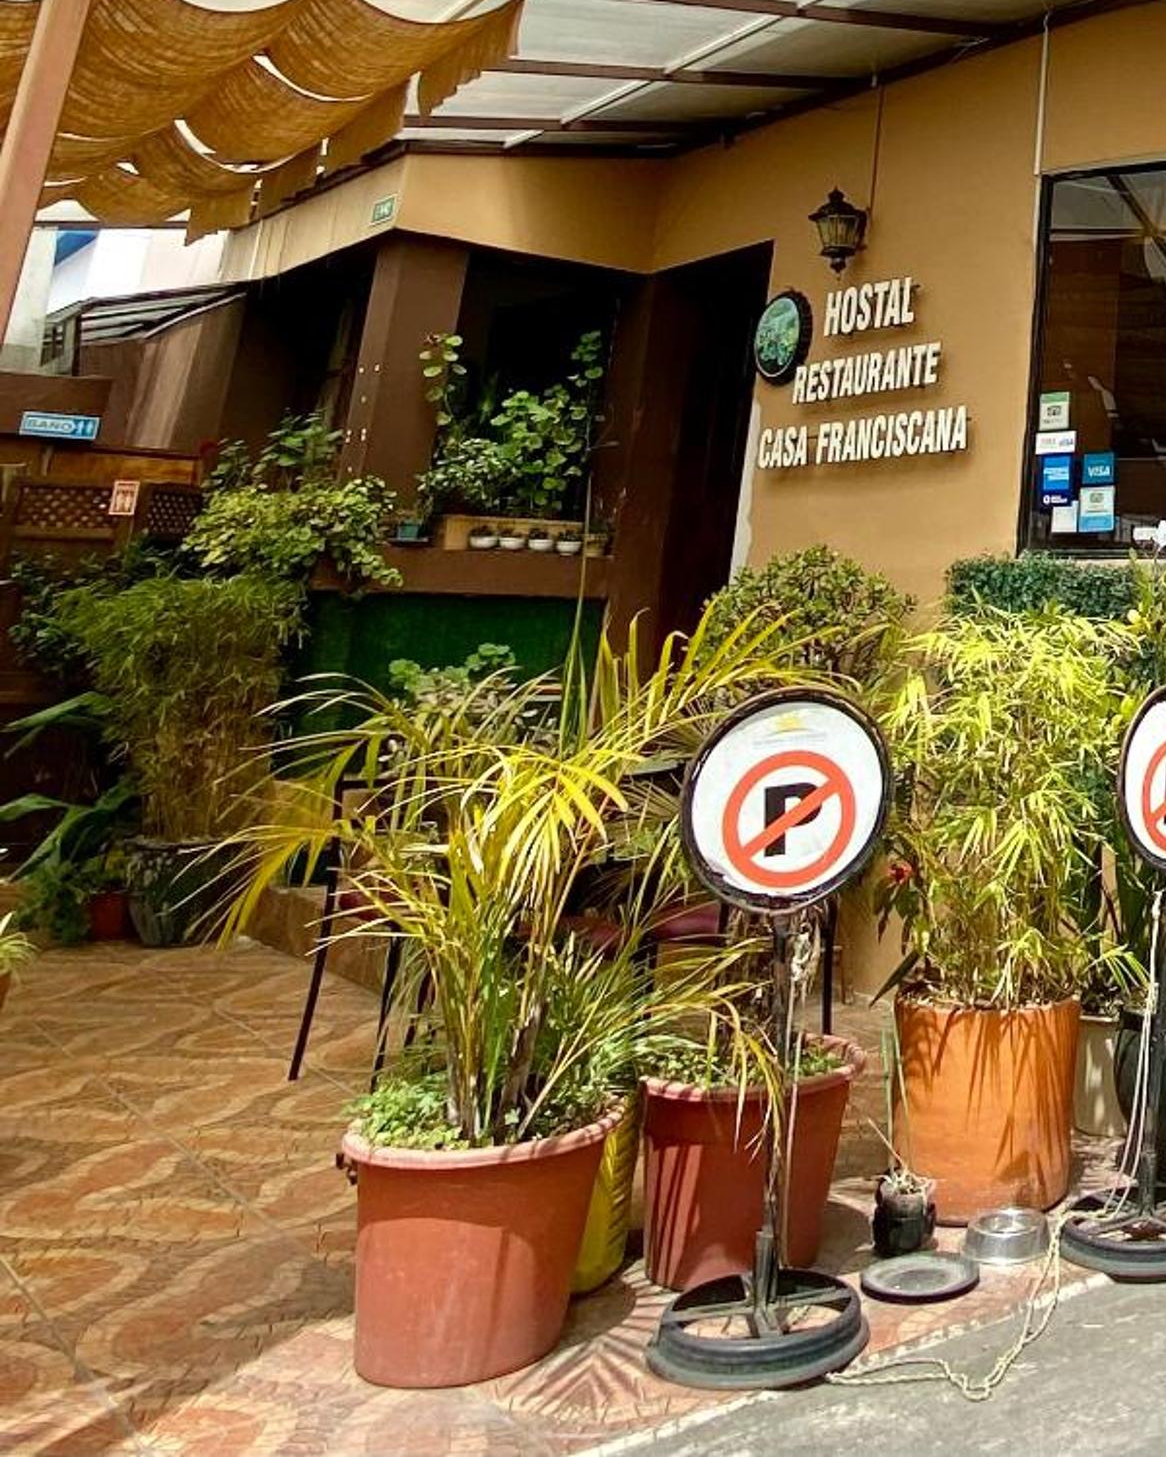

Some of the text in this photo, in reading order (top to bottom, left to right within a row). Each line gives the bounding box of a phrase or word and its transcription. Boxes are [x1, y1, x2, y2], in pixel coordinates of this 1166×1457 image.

[823, 277, 915, 337] HOSTAL
[792, 342, 942, 405] RESTAURANTE
[758, 406, 968, 469] CASA FRANCISCANA
[1087, 465, 1110, 478] VISA
[764, 782, 823, 858] P
